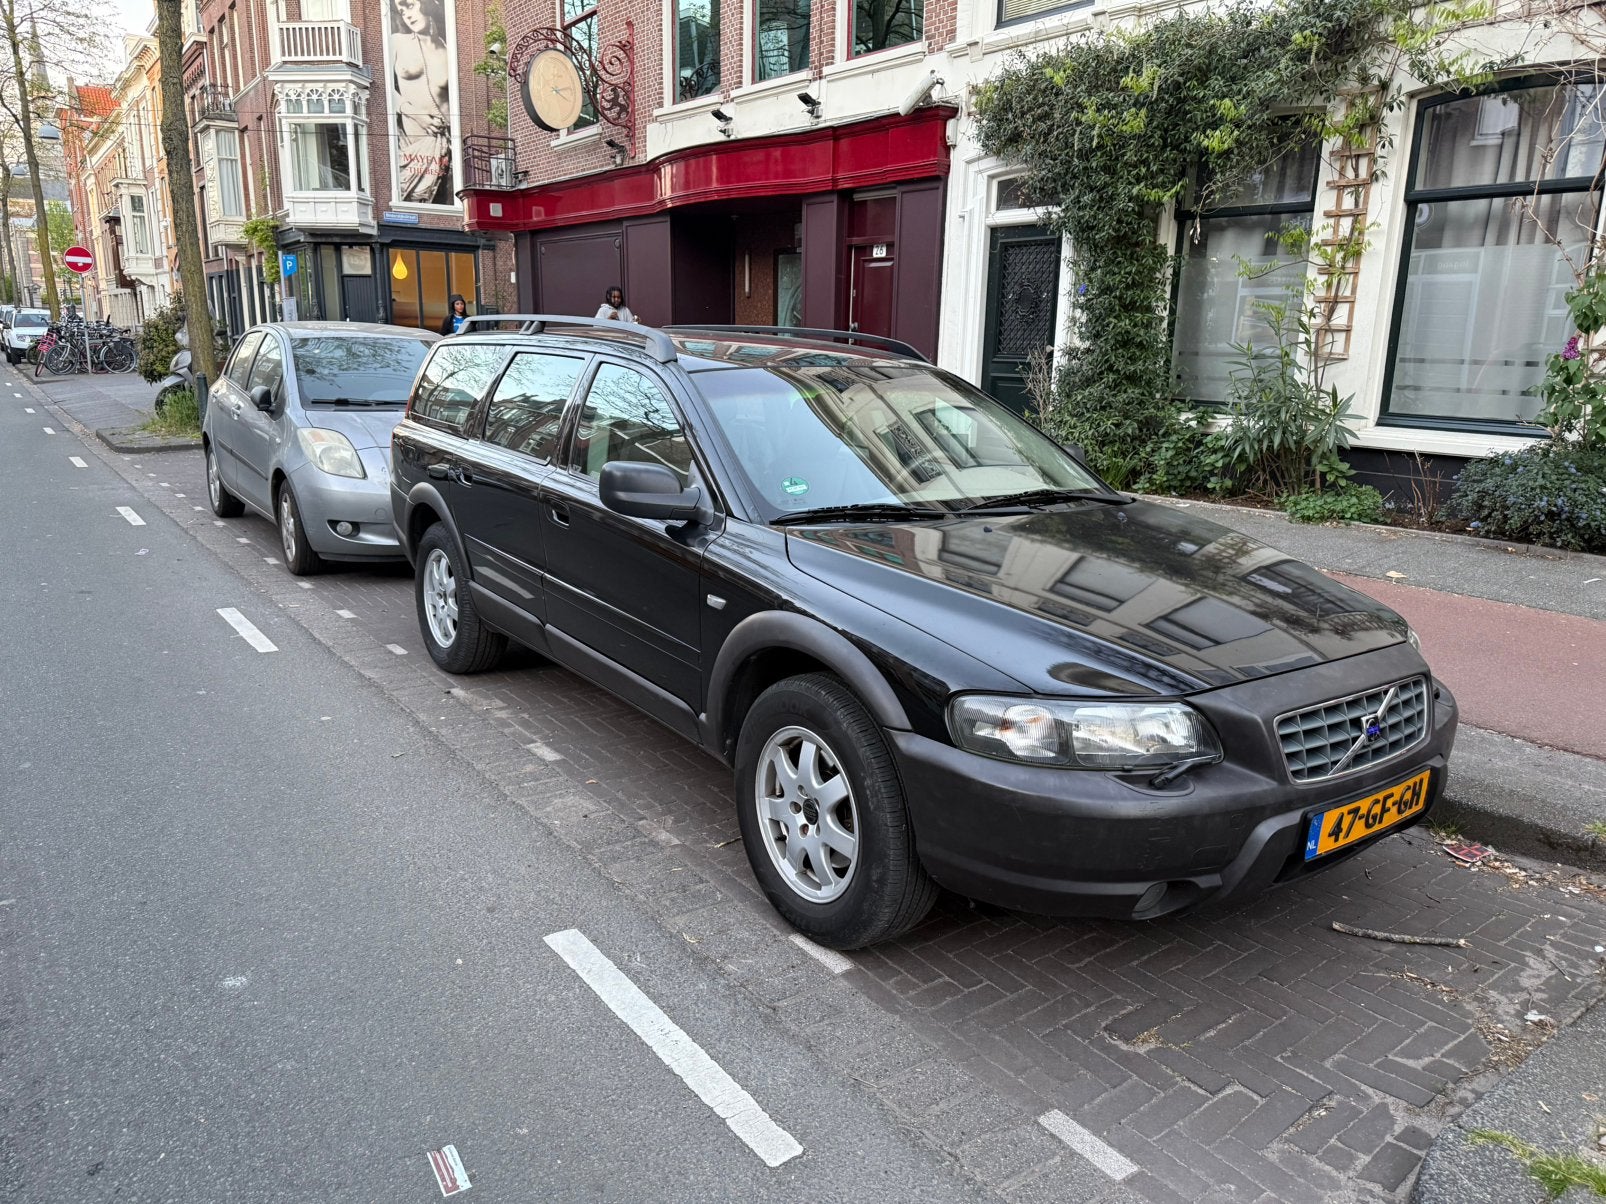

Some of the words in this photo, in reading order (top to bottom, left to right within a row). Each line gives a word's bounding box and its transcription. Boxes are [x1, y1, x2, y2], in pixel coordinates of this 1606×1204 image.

[875, 245, 884, 255] 26
[286, 260, 293, 270] P
[1306, 840, 1317, 851] NL
[1327, 777, 1424, 843] 47-GF-GH
